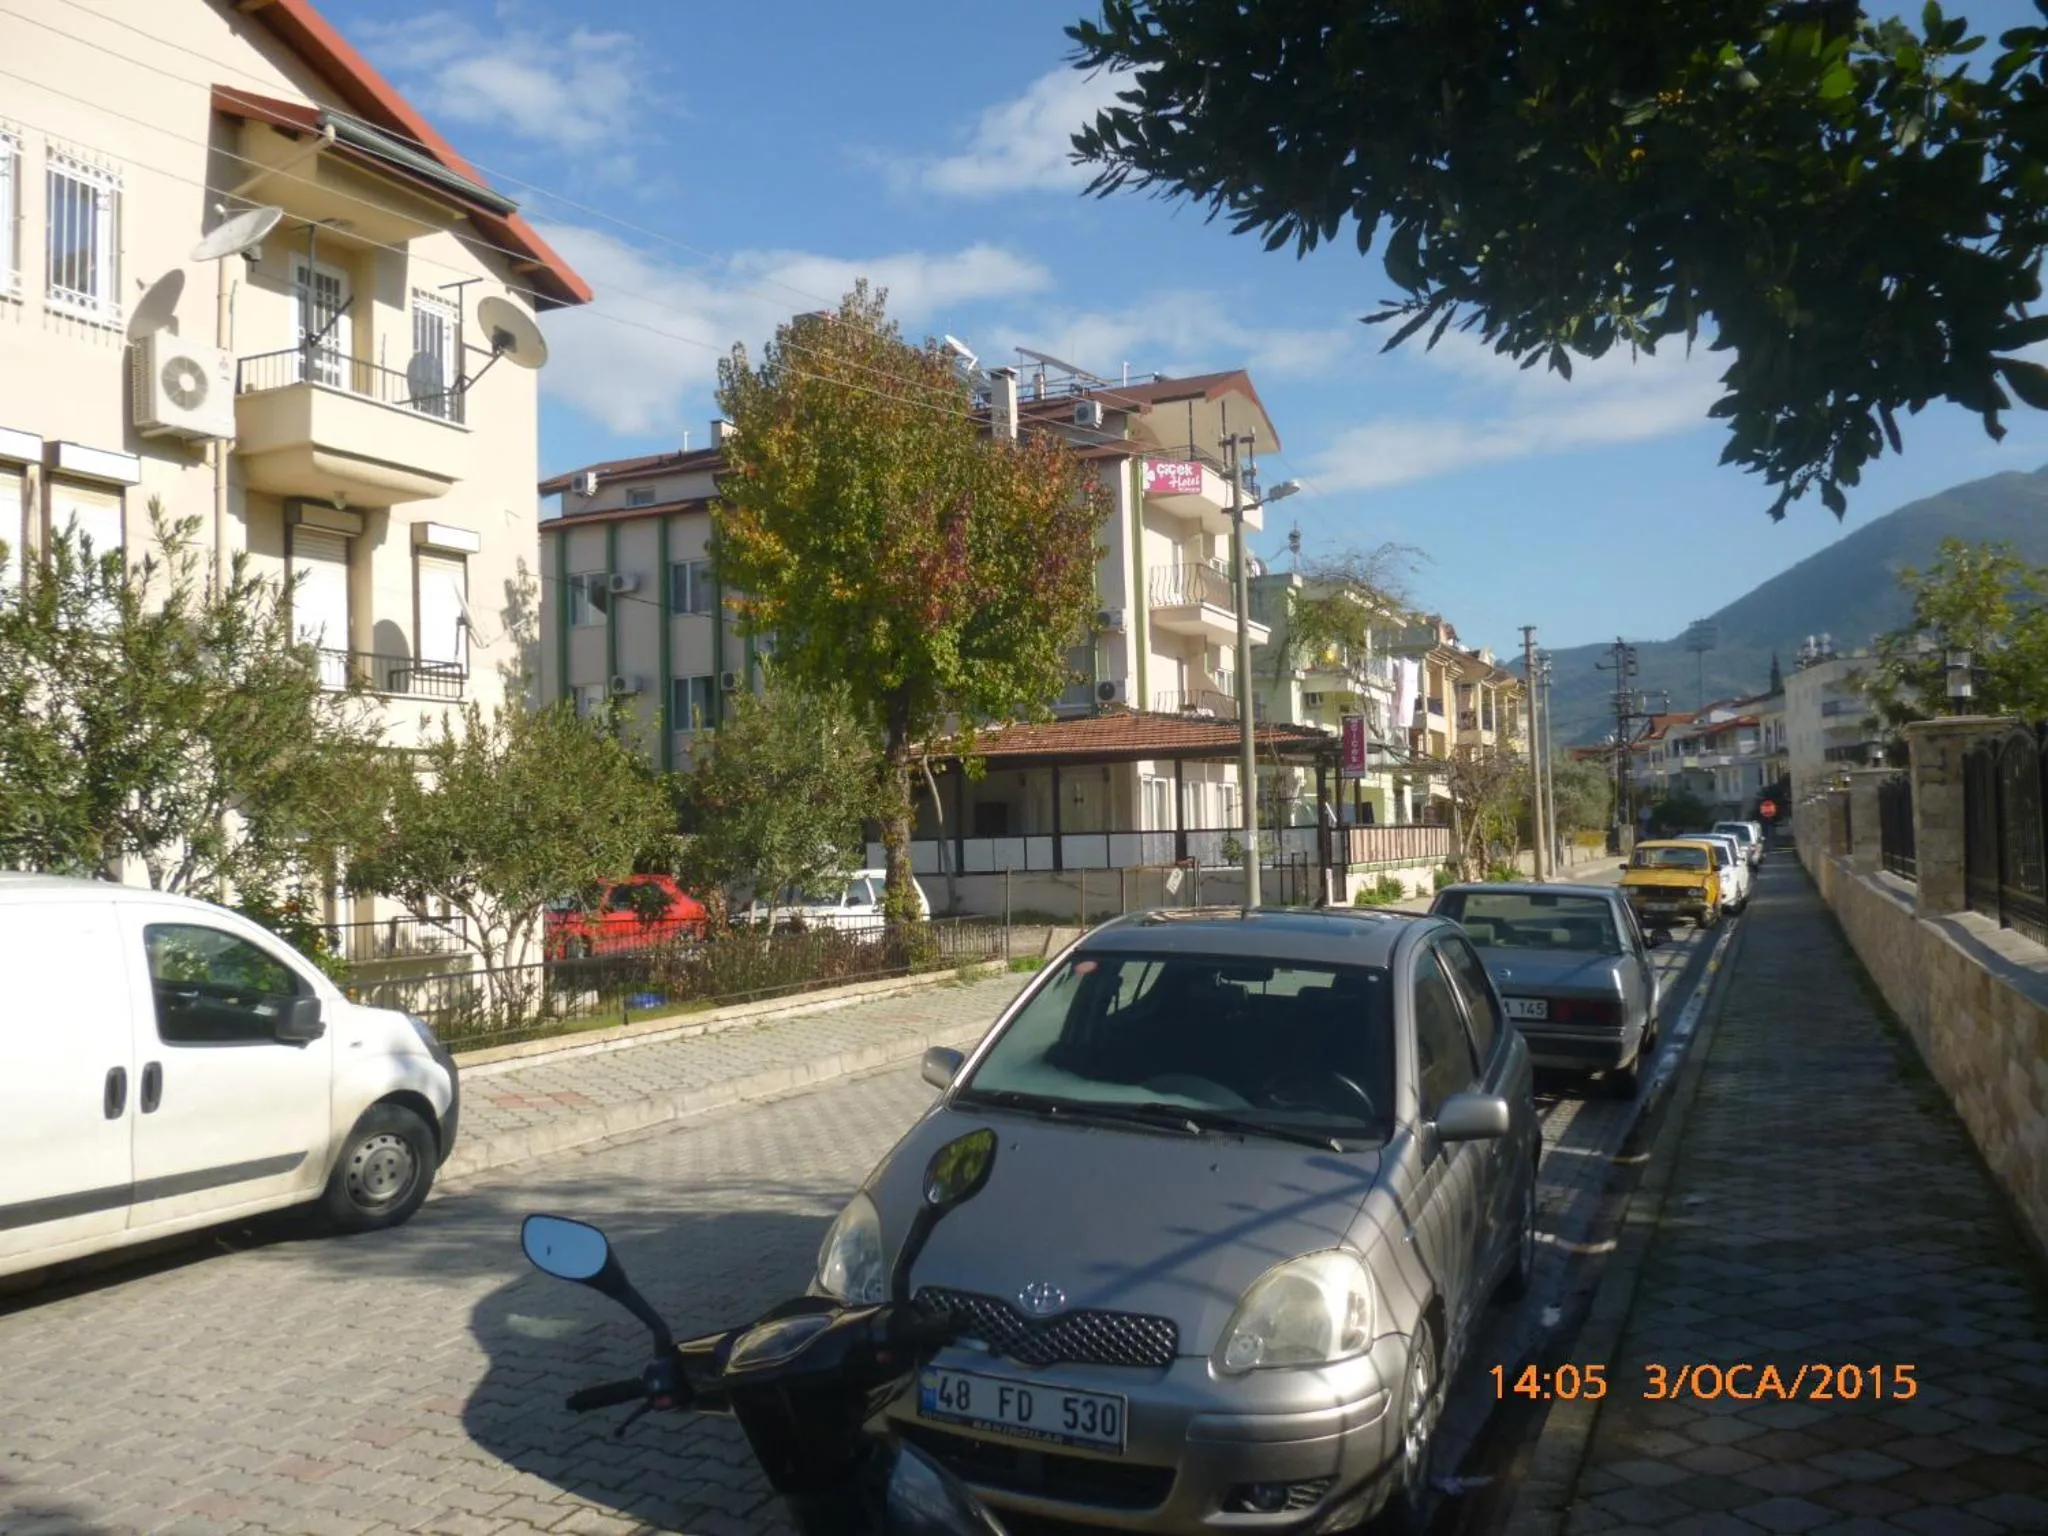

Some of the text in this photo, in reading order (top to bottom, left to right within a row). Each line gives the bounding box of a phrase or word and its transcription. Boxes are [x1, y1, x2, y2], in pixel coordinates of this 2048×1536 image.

[938, 1376, 1117, 1437] 48 FD 530
